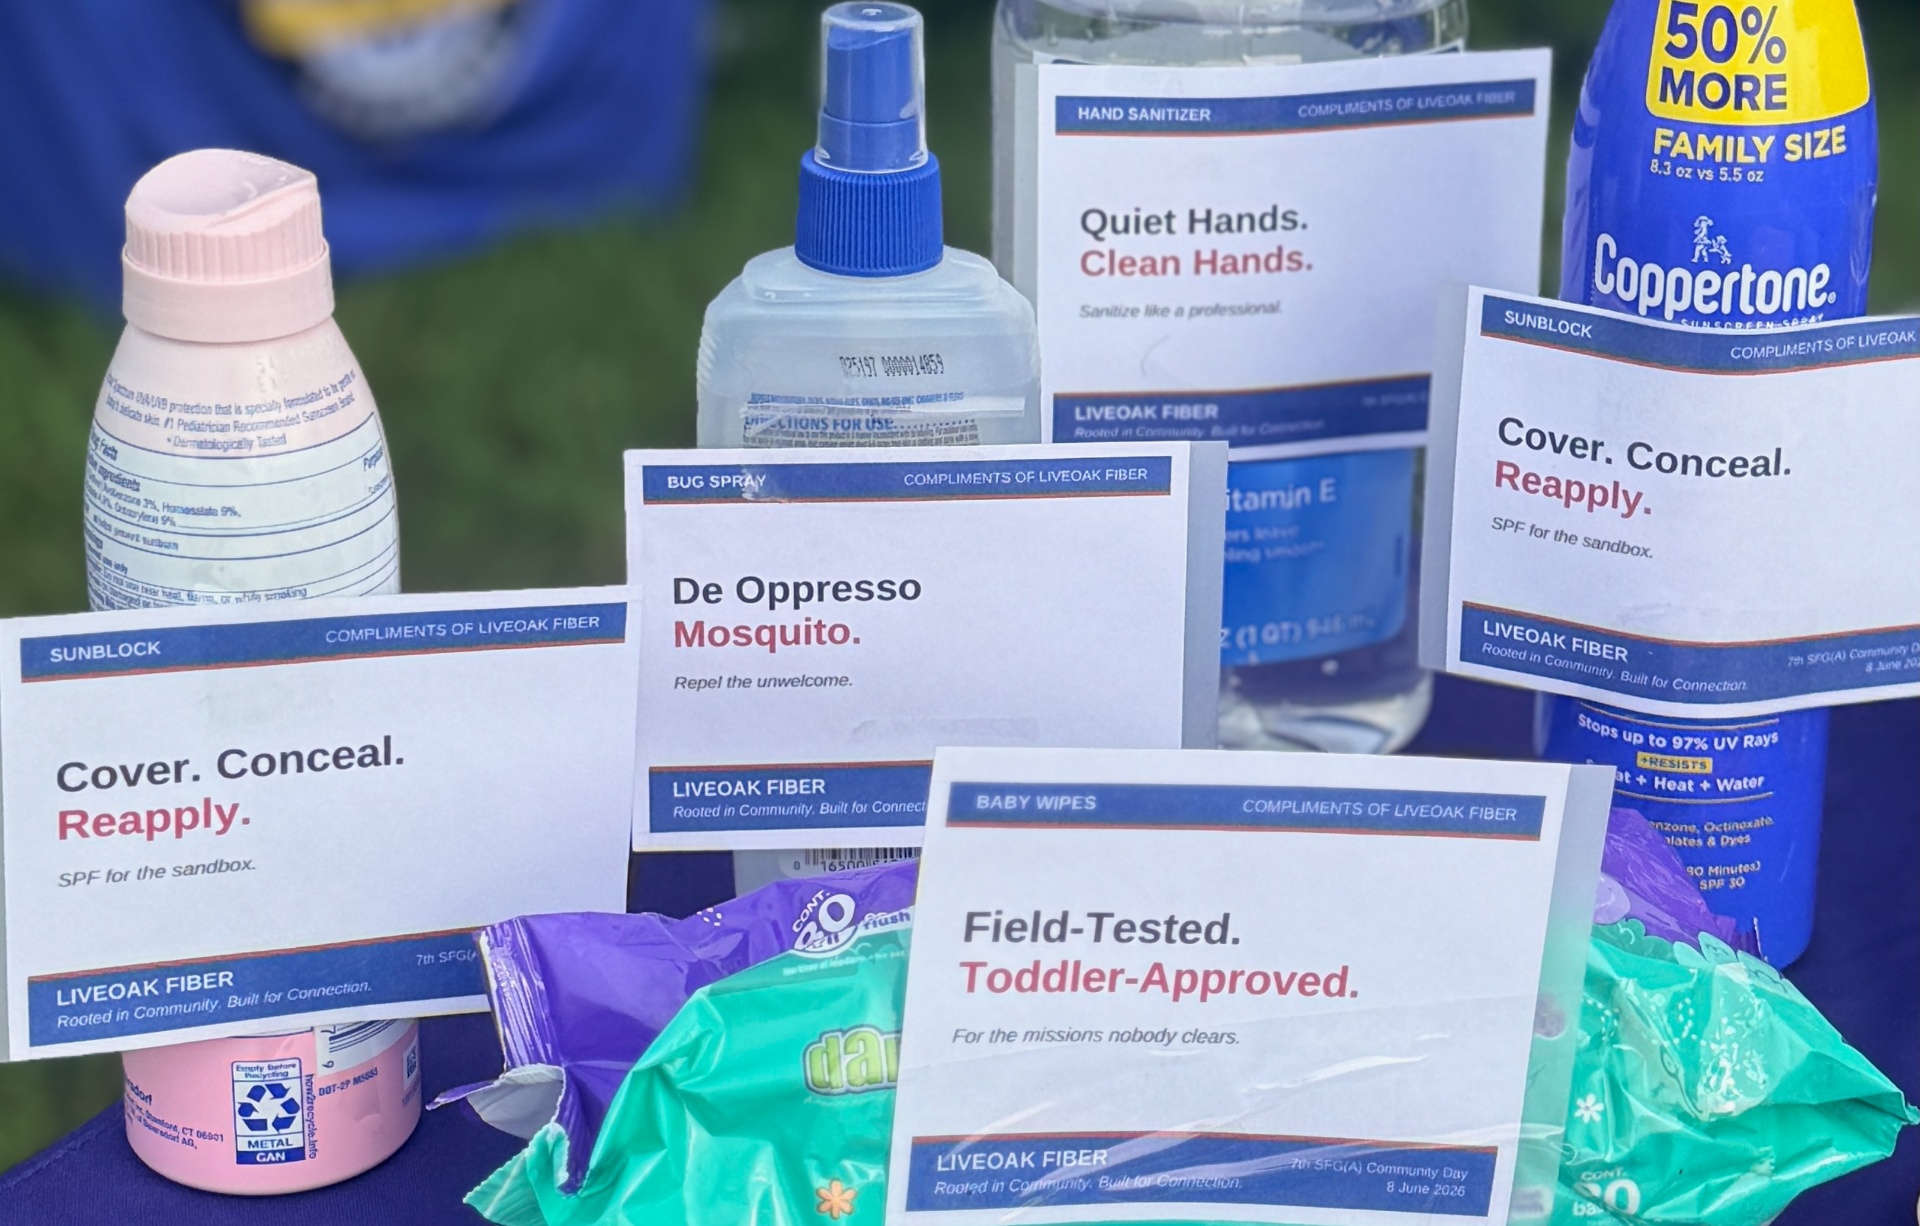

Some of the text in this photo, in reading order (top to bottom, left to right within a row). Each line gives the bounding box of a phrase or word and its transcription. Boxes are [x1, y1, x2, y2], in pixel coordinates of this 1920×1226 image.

[1664, 1, 1788, 64] 50%
[1658, 66, 1788, 111] MORE
[1077, 106, 1212, 122] HAND SANITIZER
[1297, 91, 1516, 118] COMPLIMENTS OF LIVEOAK FIBER
[1653, 125, 1848, 163] FAMILY SIZE
[1650, 159, 1765, 183] 8.3 oz vs 5.5 oz
[1080, 204, 1309, 242] Quiet Hands.
[1080, 244, 1314, 278] Clean Hands.
[1079, 301, 1283, 321] Sanitize like a professional.
[1504, 309, 1593, 339] SUNBLOCK
[1730, 330, 1917, 360] COMPLIMENTS OF LIVEOAK
[832, 417, 862, 431] FOR
[1074, 404, 1219, 421] LIVEOAK FIBER
[1497, 416, 1793, 479] Cover. Conceal.
[666, 472, 767, 490] BUG SPRAY
[903, 467, 1148, 488] COMPLIMENTS OF LIVEOAK FIBER
[1495, 459, 1653, 520] Reapply.
[1318, 477, 1337, 503] E
[1491, 515, 1654, 559] SPF for the sandbox.
[672, 572, 923, 611] De Oppresso
[325, 616, 601, 643] COMPLIMENTS OF LIVEOAK FIBER
[673, 615, 862, 653] Mosquito.
[1482, 619, 1630, 664] LIVEOAK FIBER
[49, 640, 162, 663] SUNBLOCK
[1787, 655, 1804, 667] 7th
[1806, 649, 1847, 666] SFG(A)
[1849, 643, 1910, 660] Community
[1481, 642, 1670, 690] Rooted in Community. Built for
[673, 672, 854, 692] Repel the unwelcome.
[1578, 712, 1780, 751] Stops up to 97% UV Rays
[56, 734, 405, 793] Cover. Conceal.
[672, 777, 827, 798] LIVEOAK FIBER
[1653, 776, 1695, 793] Heat
[1715, 775, 1766, 793] Water
[672, 801, 868, 820] Rooted in Community. Built for
[975, 794, 1097, 812] BABY WIPES
[1243, 798, 1518, 823] COMPLIMENTS OF LIVEOAK FIBER
[58, 796, 252, 842] Reapply.
[1720, 834, 1752, 849] Dyes
[57, 856, 257, 888] SPF for the sandbox.
[793, 861, 801, 871] 0
[1708, 861, 1762, 877] Minutes)
[1699, 878, 1725, 891] SPF
[862, 911, 911, 930] flush
[962, 910, 1242, 947] Field-Tested.
[416, 953, 435, 966] 7th
[56, 971, 235, 1007] LIVEOAK FIBER
[958, 960, 1360, 1004] Toddler-Approved.
[57, 980, 372, 1030] Rooted in Community. Built for Connection.
[952, 1025, 1242, 1048] For the missions nobody clears.
[181, 1126, 195, 1137] CT
[247, 1137, 294, 1150] METAL
[255, 1151, 286, 1163] CAN
[937, 1148, 1109, 1172] LIVEOAK FIBER
[1291, 1158, 1470, 1182] 7th SFG(A) Community Day
[934, 1173, 1244, 1195] Rooted in Community. Built for Connection.
[1386, 1181, 1467, 1198] 8 June 2026
